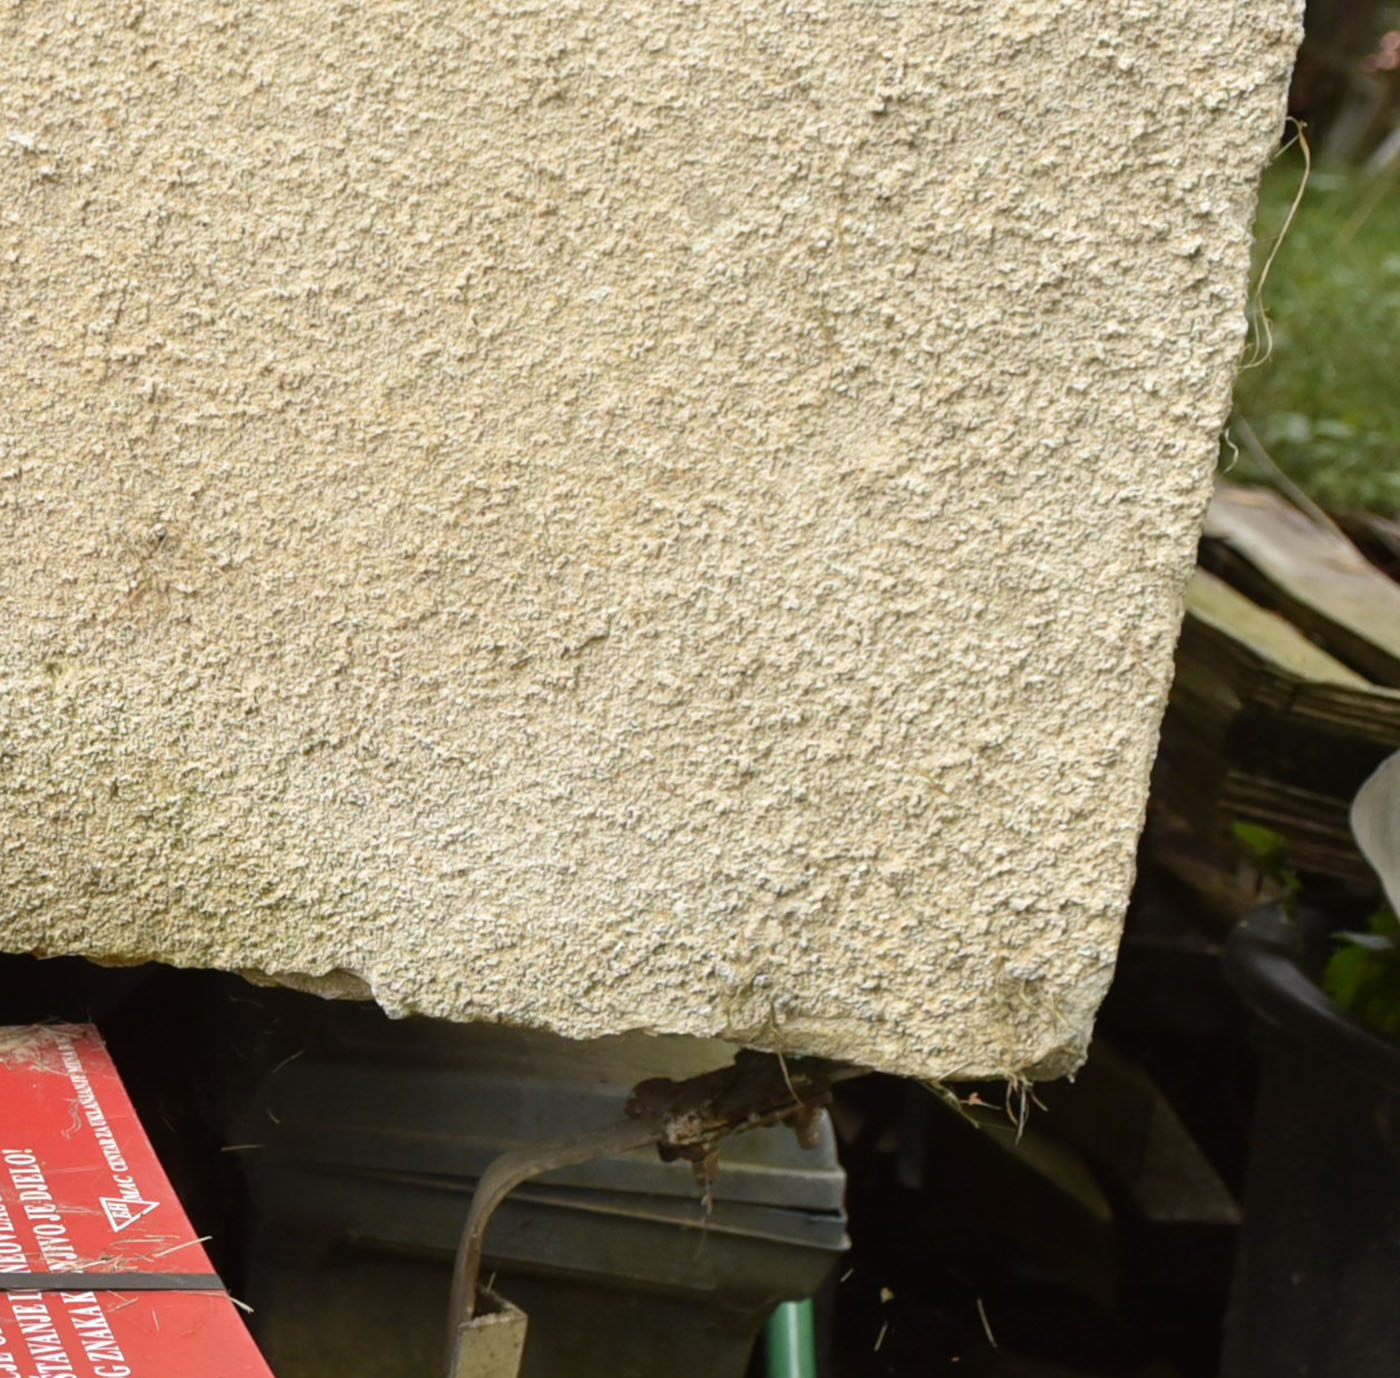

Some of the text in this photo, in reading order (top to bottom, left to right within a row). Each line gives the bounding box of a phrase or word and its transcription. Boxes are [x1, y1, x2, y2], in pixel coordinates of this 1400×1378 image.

[96, 1139, 129, 1171] CENTAR
[0, 1148, 53, 1200] DJELO!
[114, 1175, 143, 1200] MAC
[23, 1204, 62, 1221] JE
[67, 1307, 126, 1362] ZNAKA
